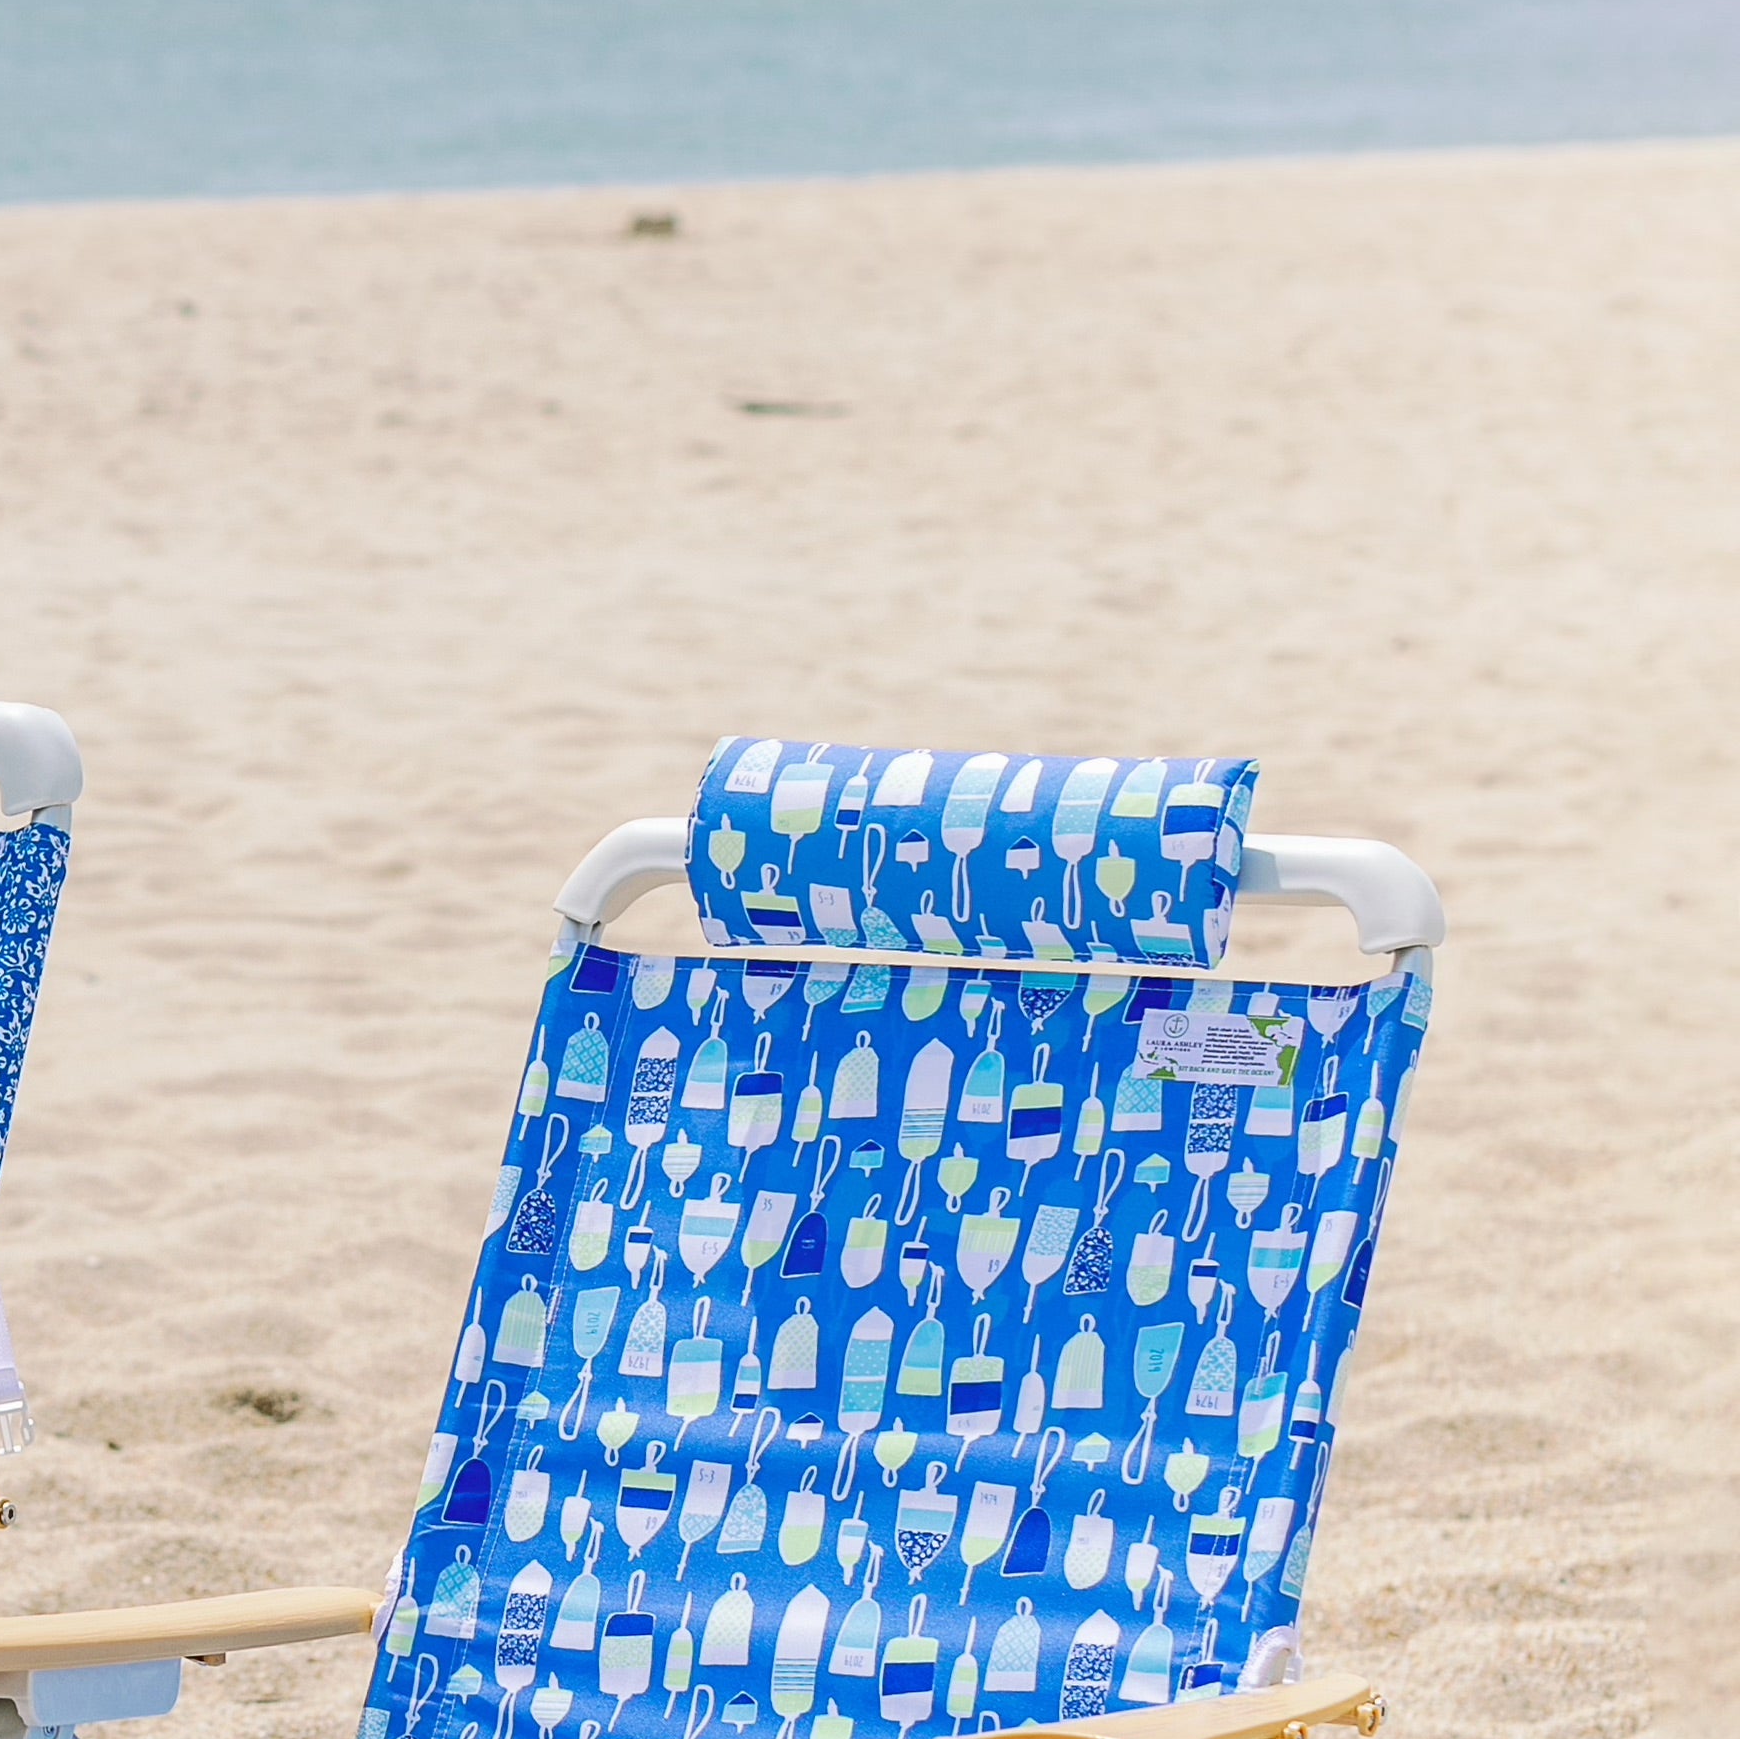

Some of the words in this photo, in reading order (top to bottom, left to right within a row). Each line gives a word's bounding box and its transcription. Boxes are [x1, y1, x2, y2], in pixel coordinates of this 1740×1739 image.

[585, 1310, 602, 1337] 2019
[627, 1354, 650, 1372] 1979
[1146, 1347, 1166, 1374] 2019
[1195, 1394, 1220, 1411] 1979
[698, 1468, 716, 1484] S-3
[979, 1491, 999, 1507] 1979
